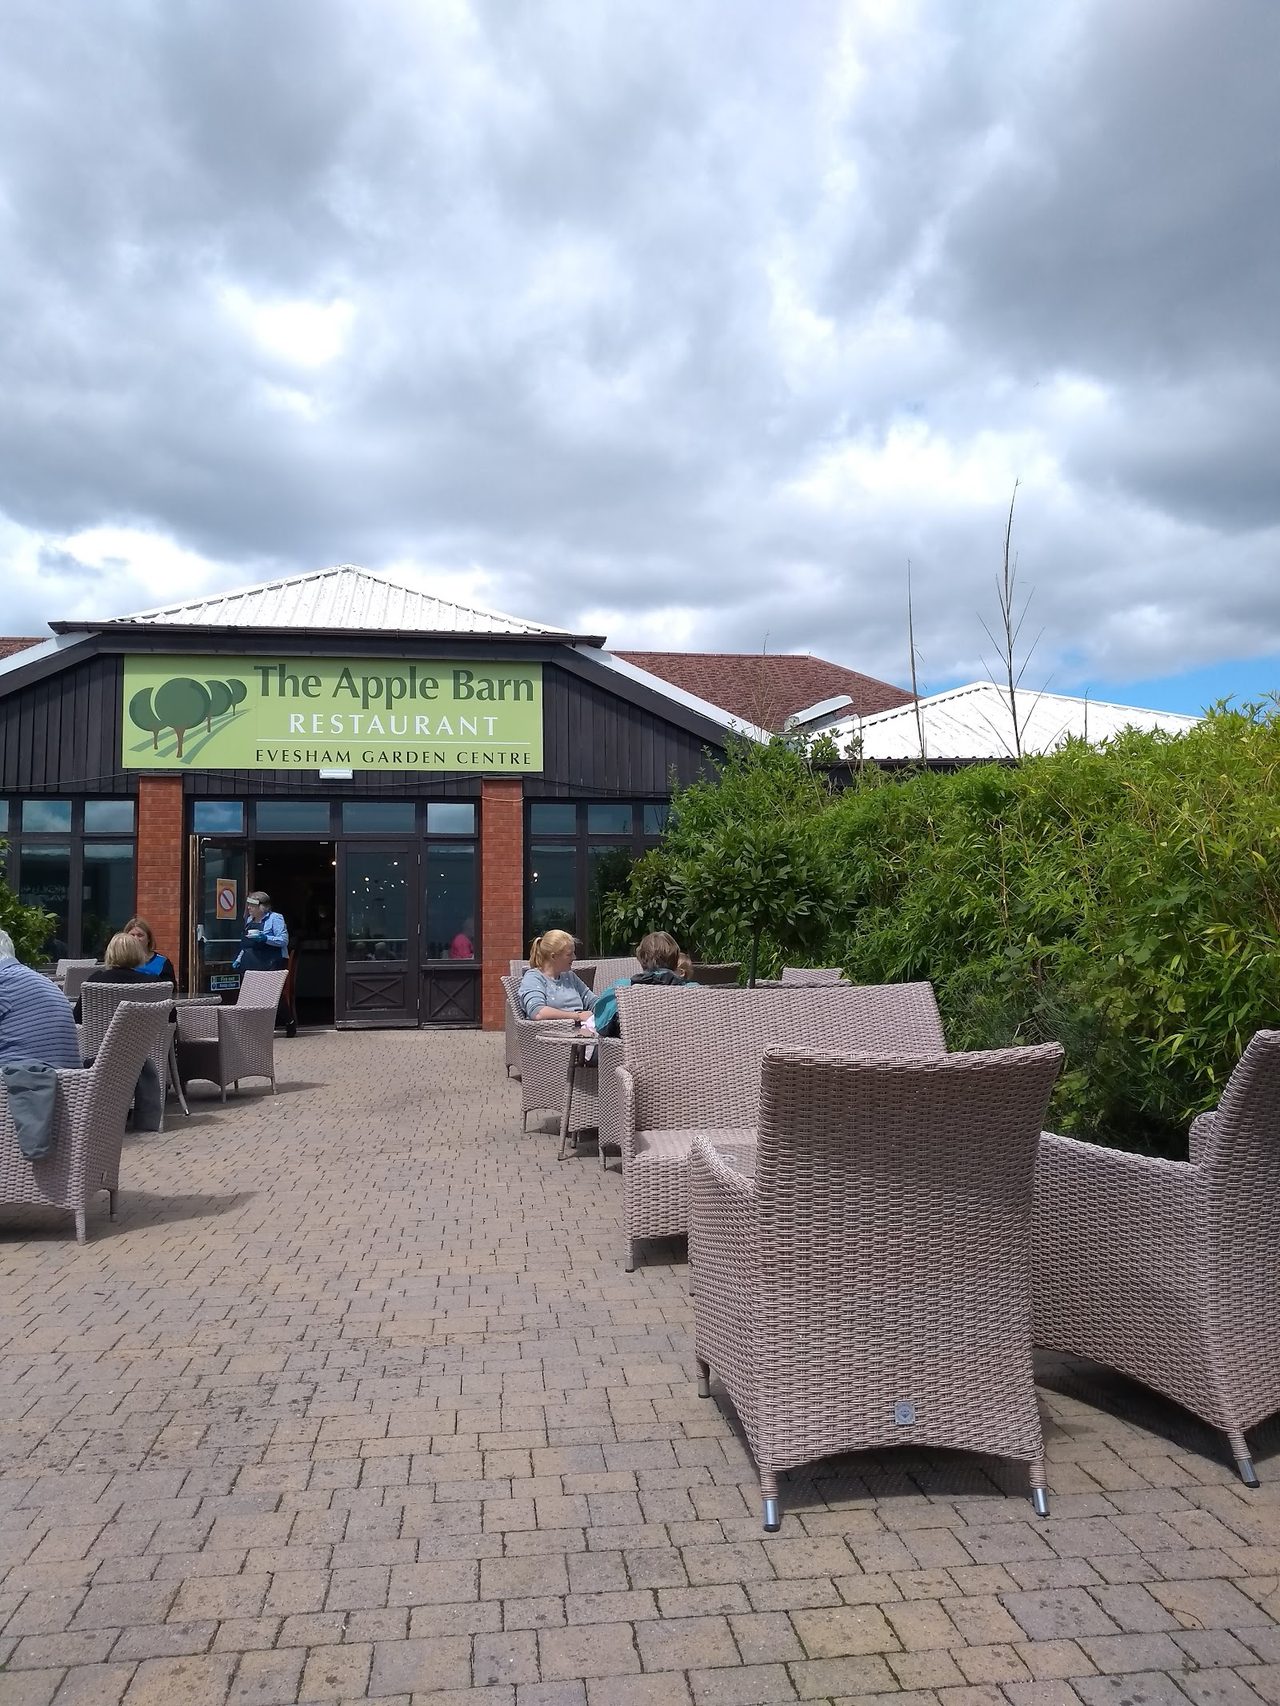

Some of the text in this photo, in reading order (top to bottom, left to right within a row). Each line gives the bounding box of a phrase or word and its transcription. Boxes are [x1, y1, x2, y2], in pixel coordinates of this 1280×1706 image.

[253, 664, 534, 710] The Apple Barn
[289, 713, 498, 736] RESTAURANT
[256, 749, 532, 765] EVESHAM GARDEN CENTRE
